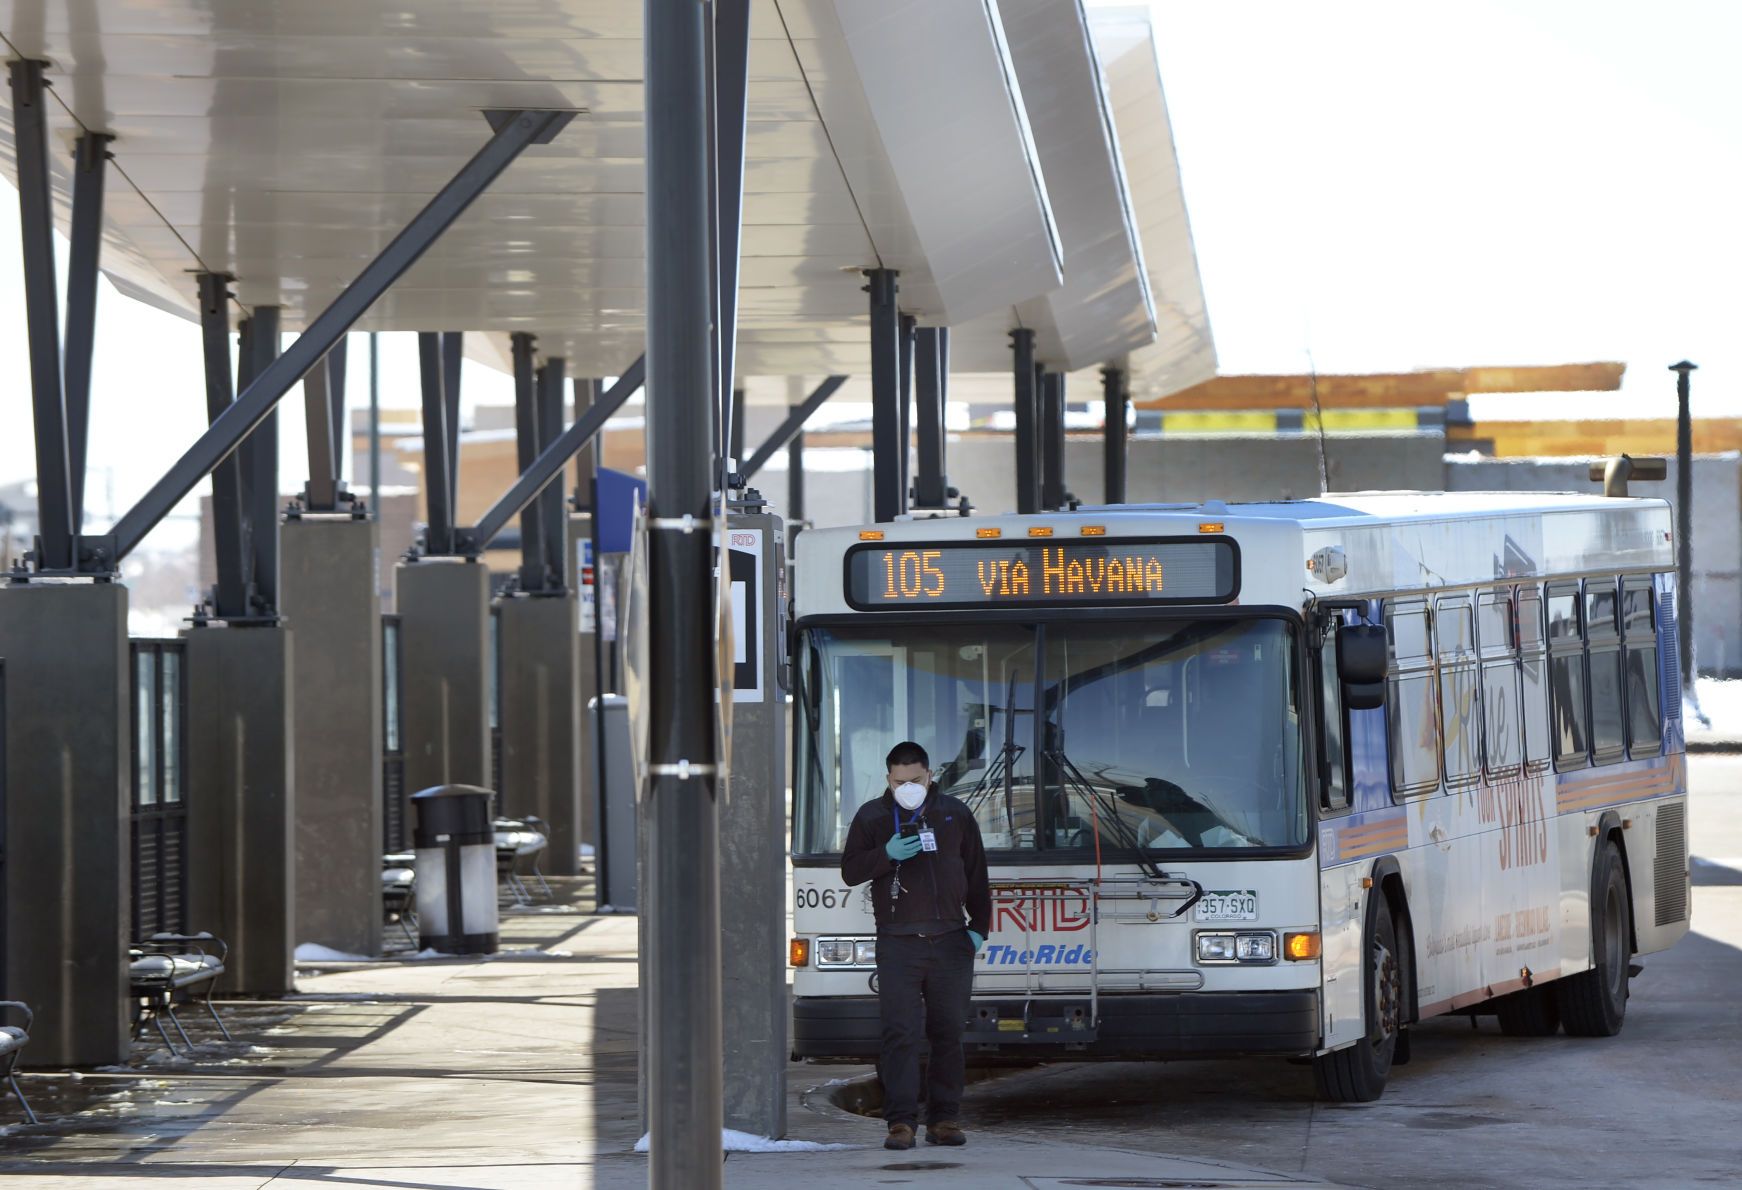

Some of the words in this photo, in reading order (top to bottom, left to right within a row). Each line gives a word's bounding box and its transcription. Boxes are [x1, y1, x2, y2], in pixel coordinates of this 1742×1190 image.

[731, 534, 756, 547] RTD
[882, 551, 945, 598] 105
[1497, 762, 1548, 871] SPIRITS
[796, 888, 852, 909] 6067
[988, 878, 1091, 933] RTD
[986, 943, 1099, 965] TheRide
